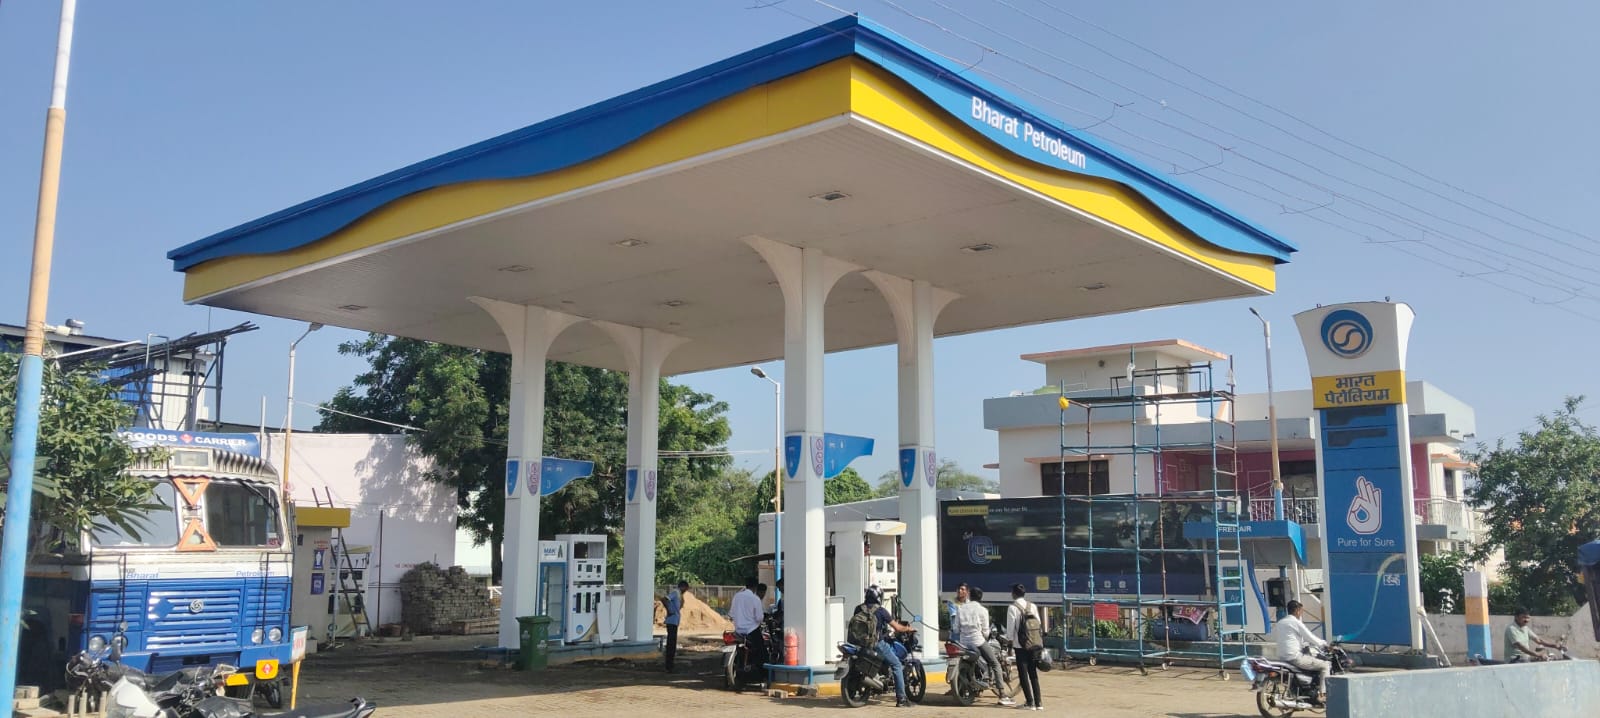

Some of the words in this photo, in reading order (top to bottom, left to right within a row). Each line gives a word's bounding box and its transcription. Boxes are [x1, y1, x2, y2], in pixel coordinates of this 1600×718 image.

[971, 96, 1019, 138] Bharat
[1023, 121, 1086, 169] Petroleum
[1335, 375, 1376, 388] भारत
[194, 436, 247, 446] CARRIER
[1337, 537, 1358, 547] Pure
[1360, 537, 1372, 547] for
[1374, 537, 1395, 547] Sure
